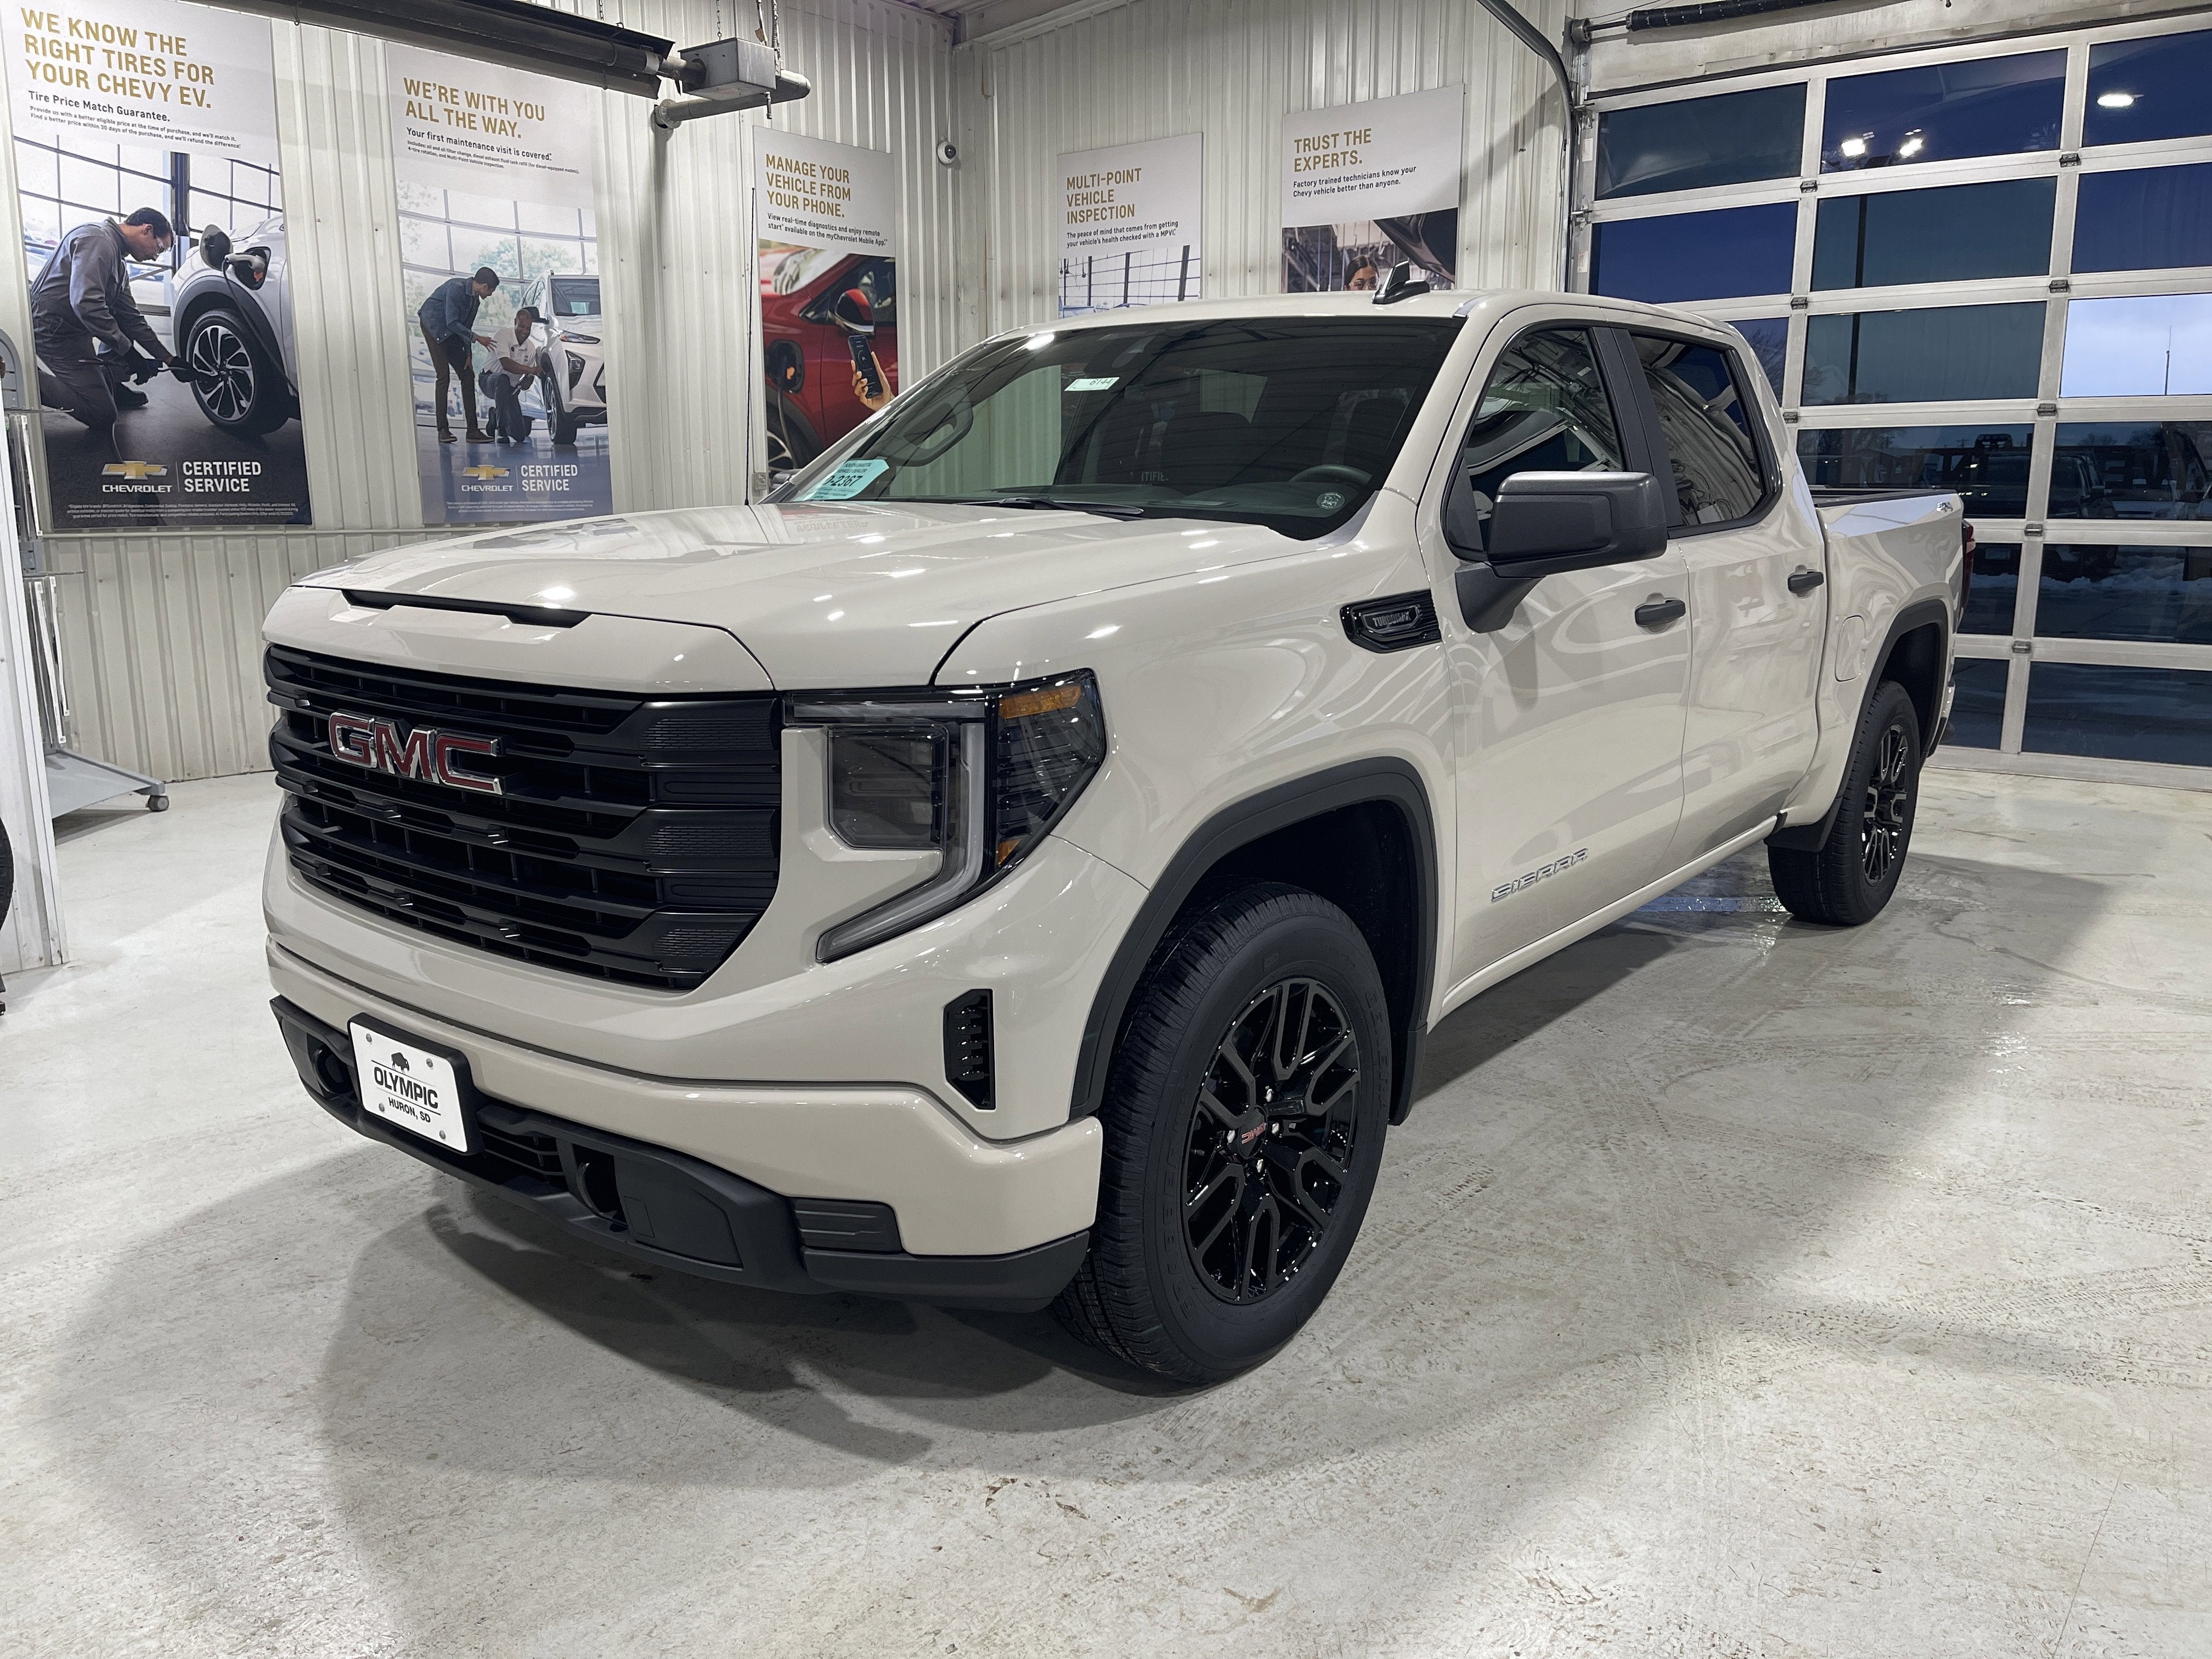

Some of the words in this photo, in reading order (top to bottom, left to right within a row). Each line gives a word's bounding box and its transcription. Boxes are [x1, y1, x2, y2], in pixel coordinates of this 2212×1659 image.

[20, 7, 60, 34] WE
[69, 17, 138, 48] KNOW
[144, 31, 187, 57] THE
[25, 34, 95, 65] RIGHT
[102, 48, 165, 77] TIRES
[174, 61, 214, 85] FOR
[25, 59, 89, 89] YOUR
[98, 73, 172, 103] CHEVY
[179, 87, 212, 108] EV.
[28, 91, 49, 103] Tire
[53, 94, 80, 108] Price
[83, 99, 114, 114] Match
[117, 106, 171, 122] Guarantee.
[30, 105, 51, 114] Provide
[404, 77, 459, 106] WE'RE
[465, 91, 508, 115] WITH
[513, 100, 545, 121] YOU
[405, 100, 439, 123] ALL
[444, 108, 477, 131] THE
[482, 116, 522, 138] WAY.
[138, 130, 163, 139] purchase,
[407, 127, 425, 138] Your
[427, 131, 444, 143] first
[447, 137, 494, 151] maintenance
[496, 145, 512, 155] visit
[514, 148, 520, 156] is
[1294, 133, 1339, 154] TRUST
[1344, 128, 1372, 146] THE
[766, 154, 816, 178] MANAGE
[820, 165, 850, 184] YOUR
[1295, 150, 1362, 172] EXPERTS.
[766, 172, 816, 195] VEHICLE
[820, 183, 851, 201] FROM
[1067, 167, 1142, 190] MULTI-POINT
[1294, 179, 1317, 188] Factory
[1319, 175, 1341, 185] trained
[1343, 171, 1380, 182] technicians
[1401, 166, 1417, 176] your
[1313, 186, 1335, 195] vehicle
[1338, 184, 1357, 193] better
[1359, 181, 1374, 190] than
[1375, 179, 1401, 188] anyone.
[767, 190, 799, 210] YOUR
[803, 197, 844, 218] PHONE.
[1066, 189, 1114, 207] VEHICLE
[768, 212, 781, 221] View
[782, 216, 807, 226] real-time
[808, 221, 837, 230] diagnostics
[849, 227, 861, 236] enjoy
[1067, 204, 1135, 224] INSPECTION
[785, 226, 808, 235] available
[826, 233, 857, 242] myChevrolet
[1077, 231, 1092, 240] peace
[1158, 220, 1178, 230] getting
[1079, 237, 1101, 246] vehicle's
[1102, 235, 1118, 244] health
[1120, 233, 1141, 241] checked
[1143, 231, 1154, 239] with
[183, 461, 262, 476] CERTIFIED
[521, 464, 578, 477] CERTIFIED
[102, 484, 172, 493] CHEVROLET
[184, 477, 251, 493] SERVICE
[522, 479, 569, 492] SERVICE
[329, 712, 503, 795] GMC
[1491, 848, 1589, 904] SIERRA
[374, 1066, 438, 1109] OLYMPIC
[388, 1097, 418, 1120] HURON,
[420, 1110, 431, 1123] SD
